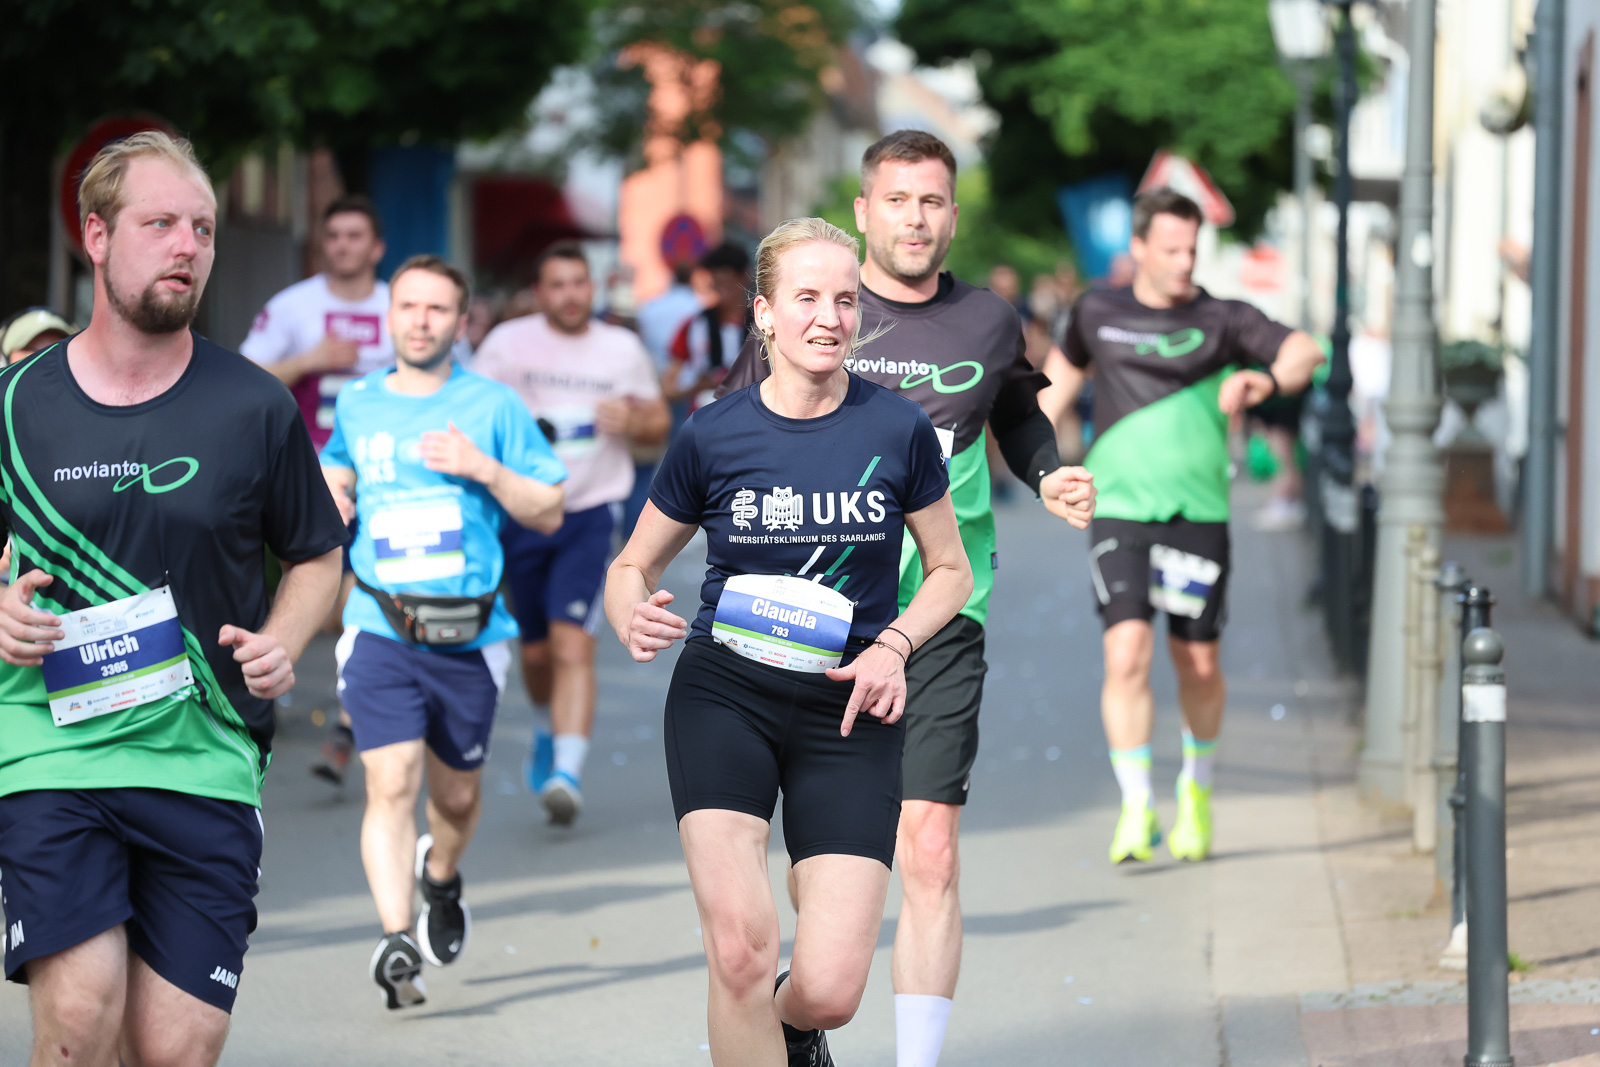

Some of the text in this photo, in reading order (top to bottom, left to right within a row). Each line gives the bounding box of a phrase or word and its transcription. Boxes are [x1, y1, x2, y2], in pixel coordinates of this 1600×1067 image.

[54, 460, 141, 483] movianto
[812, 490, 886, 525] UKS
[728, 532, 886, 544] UNIVERSITÄTSKLINIKUM DES SAARLANDES
[751, 598, 818, 630] Claudia
[771, 625, 790, 638] 793
[79, 634, 140, 665] Ulrich
[101, 660, 129, 677] 3365
[209, 965, 238, 989] JAKO
